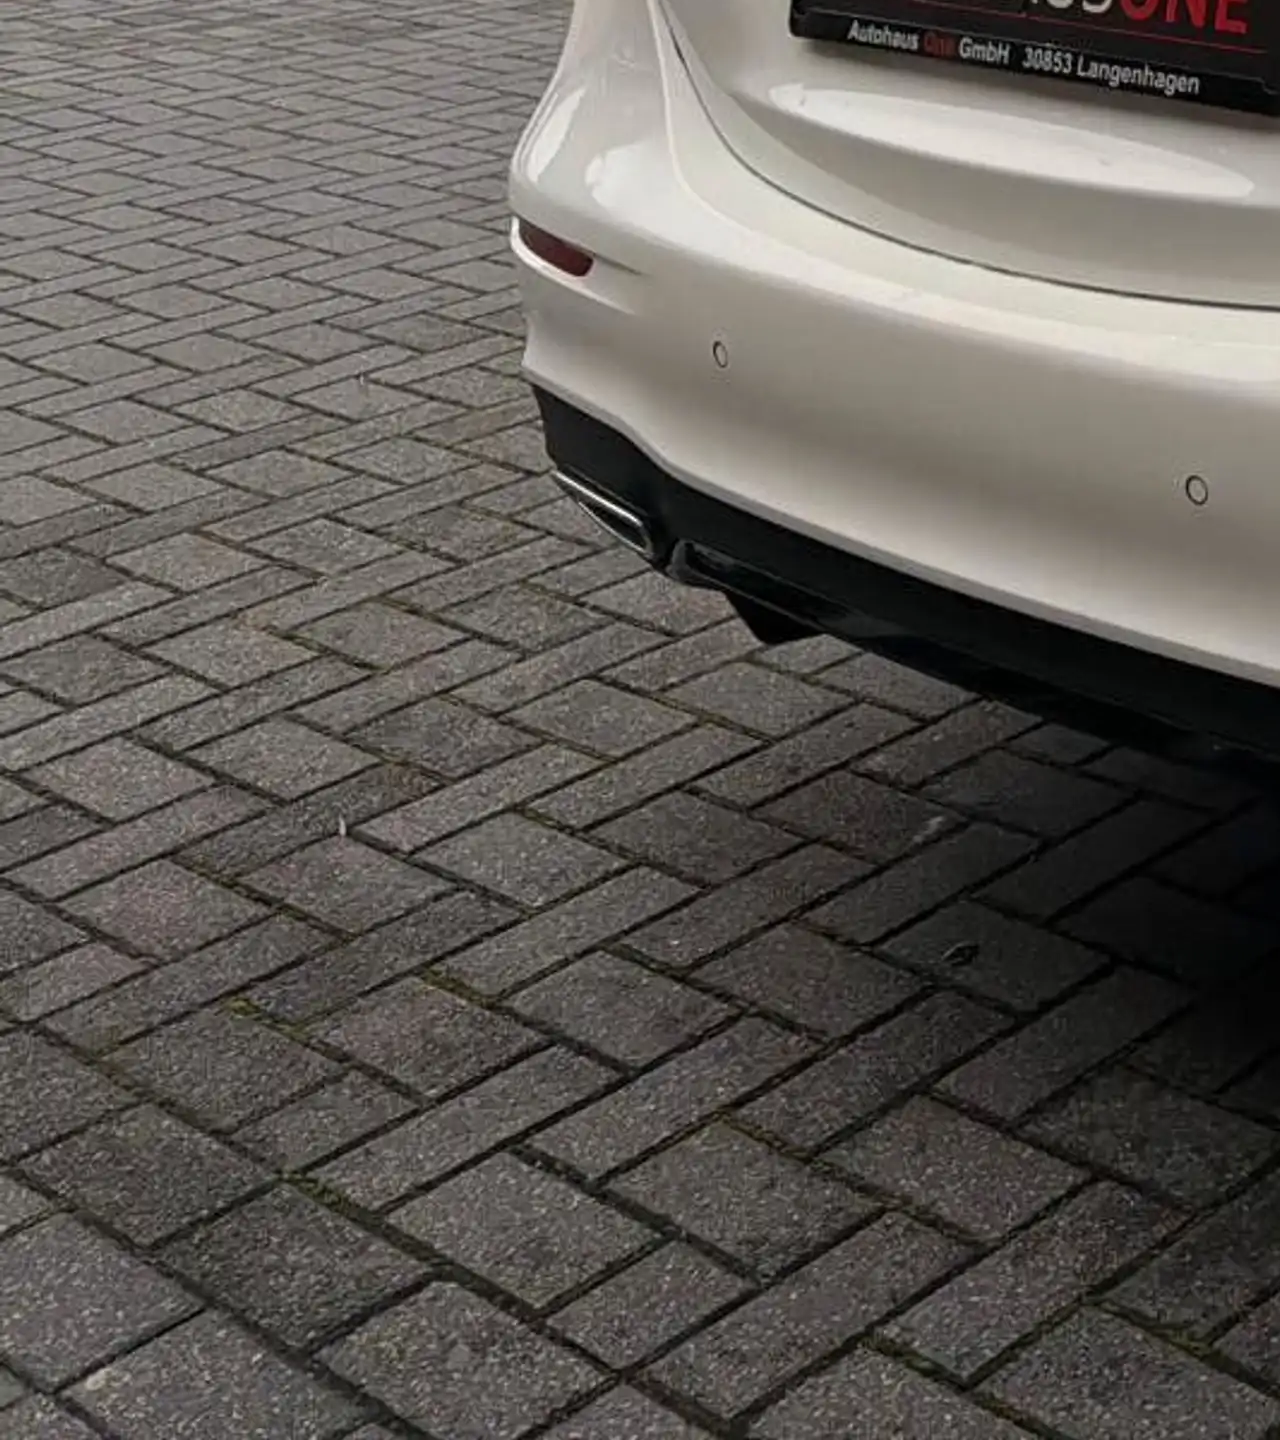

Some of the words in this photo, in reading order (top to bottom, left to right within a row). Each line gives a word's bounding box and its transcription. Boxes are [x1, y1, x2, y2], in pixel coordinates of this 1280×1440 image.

[848, 19, 919, 51] Autohaus
[959, 36, 1011, 64] GmbH
[1022, 46, 1073, 75] 30853
[1077, 53, 1200, 96] Langenhagen
